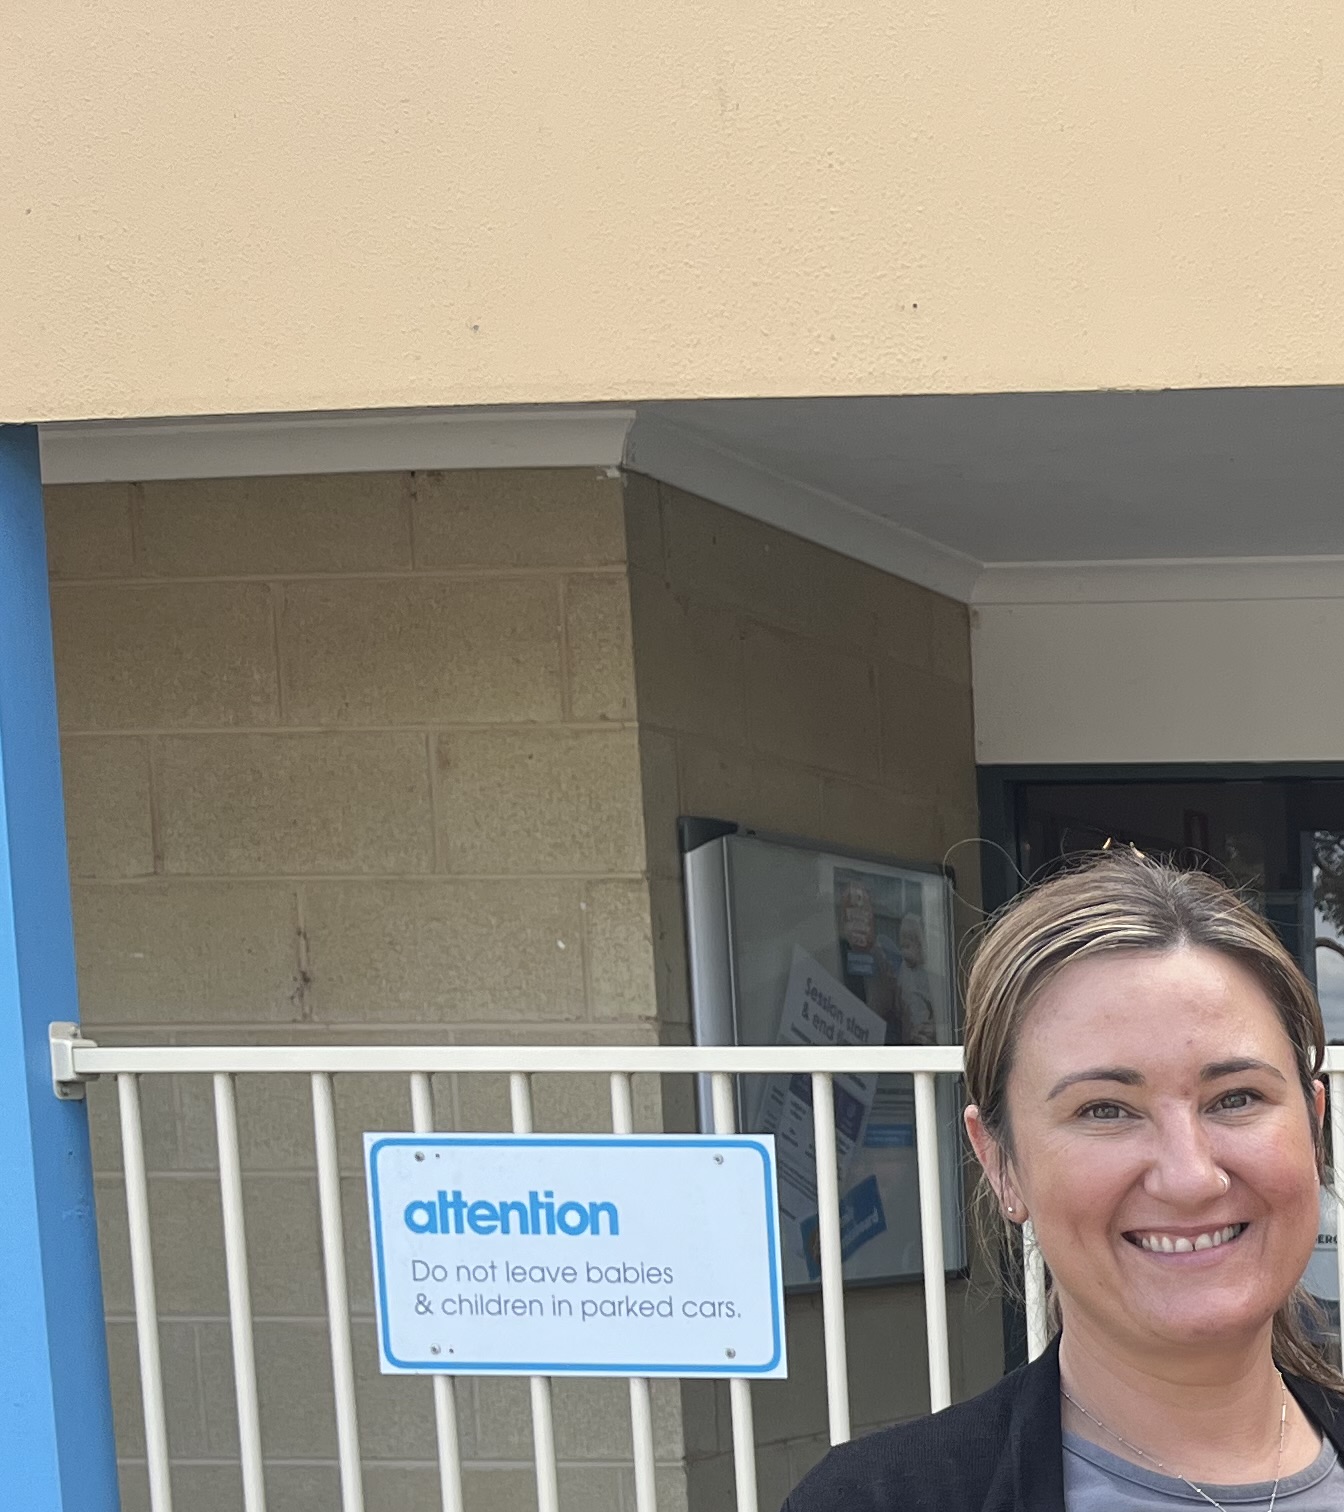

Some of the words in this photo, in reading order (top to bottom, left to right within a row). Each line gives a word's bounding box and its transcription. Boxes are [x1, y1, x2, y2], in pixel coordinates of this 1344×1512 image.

[403, 1189, 621, 1236] attention
[411, 1259, 448, 1283] Do
[455, 1259, 498, 1283] not
[505, 1260, 578, 1284] leave
[586, 1261, 674, 1285] babies
[413, 1293, 434, 1316] &
[441, 1293, 544, 1317] children
[551, 1294, 573, 1317] in
[581, 1295, 674, 1322] parked
[681, 1298, 742, 1319] cars.
